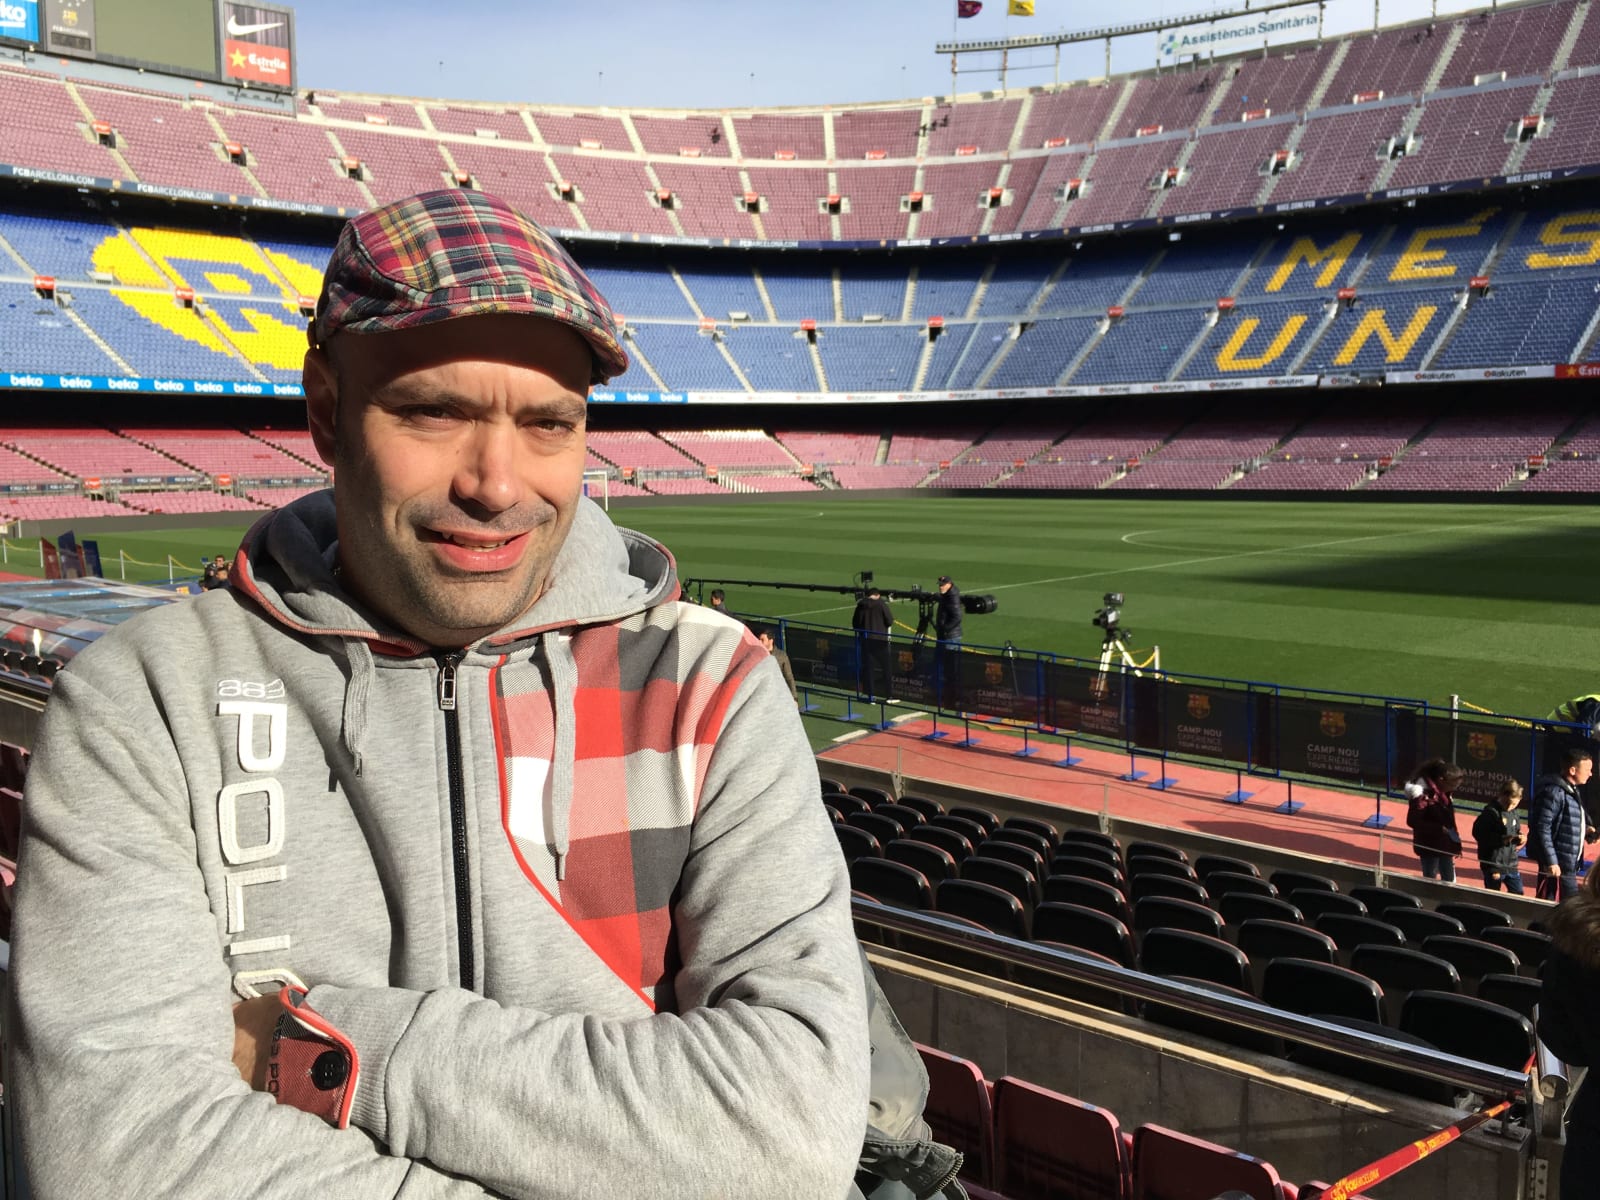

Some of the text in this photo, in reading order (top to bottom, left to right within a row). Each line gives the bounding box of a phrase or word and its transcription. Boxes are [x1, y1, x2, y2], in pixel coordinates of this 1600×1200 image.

[1181, 14, 1318, 46] Assistència Sanitària
[13, 167, 95, 185] FCBARCELONA.COM
[137, 183, 213, 200] FCBARCELONA.COM
[10, 374, 43, 387] beko
[60, 376, 92, 389] beko
[108, 378, 139, 390] beko
[154, 380, 184, 391] beko
[194, 381, 223, 393] beko
[233, 382, 262, 394] beko
[273, 384, 301, 395] beko
[1307, 744, 1360, 758] CAMP NOU
[1461, 768, 1485, 777] AMP
